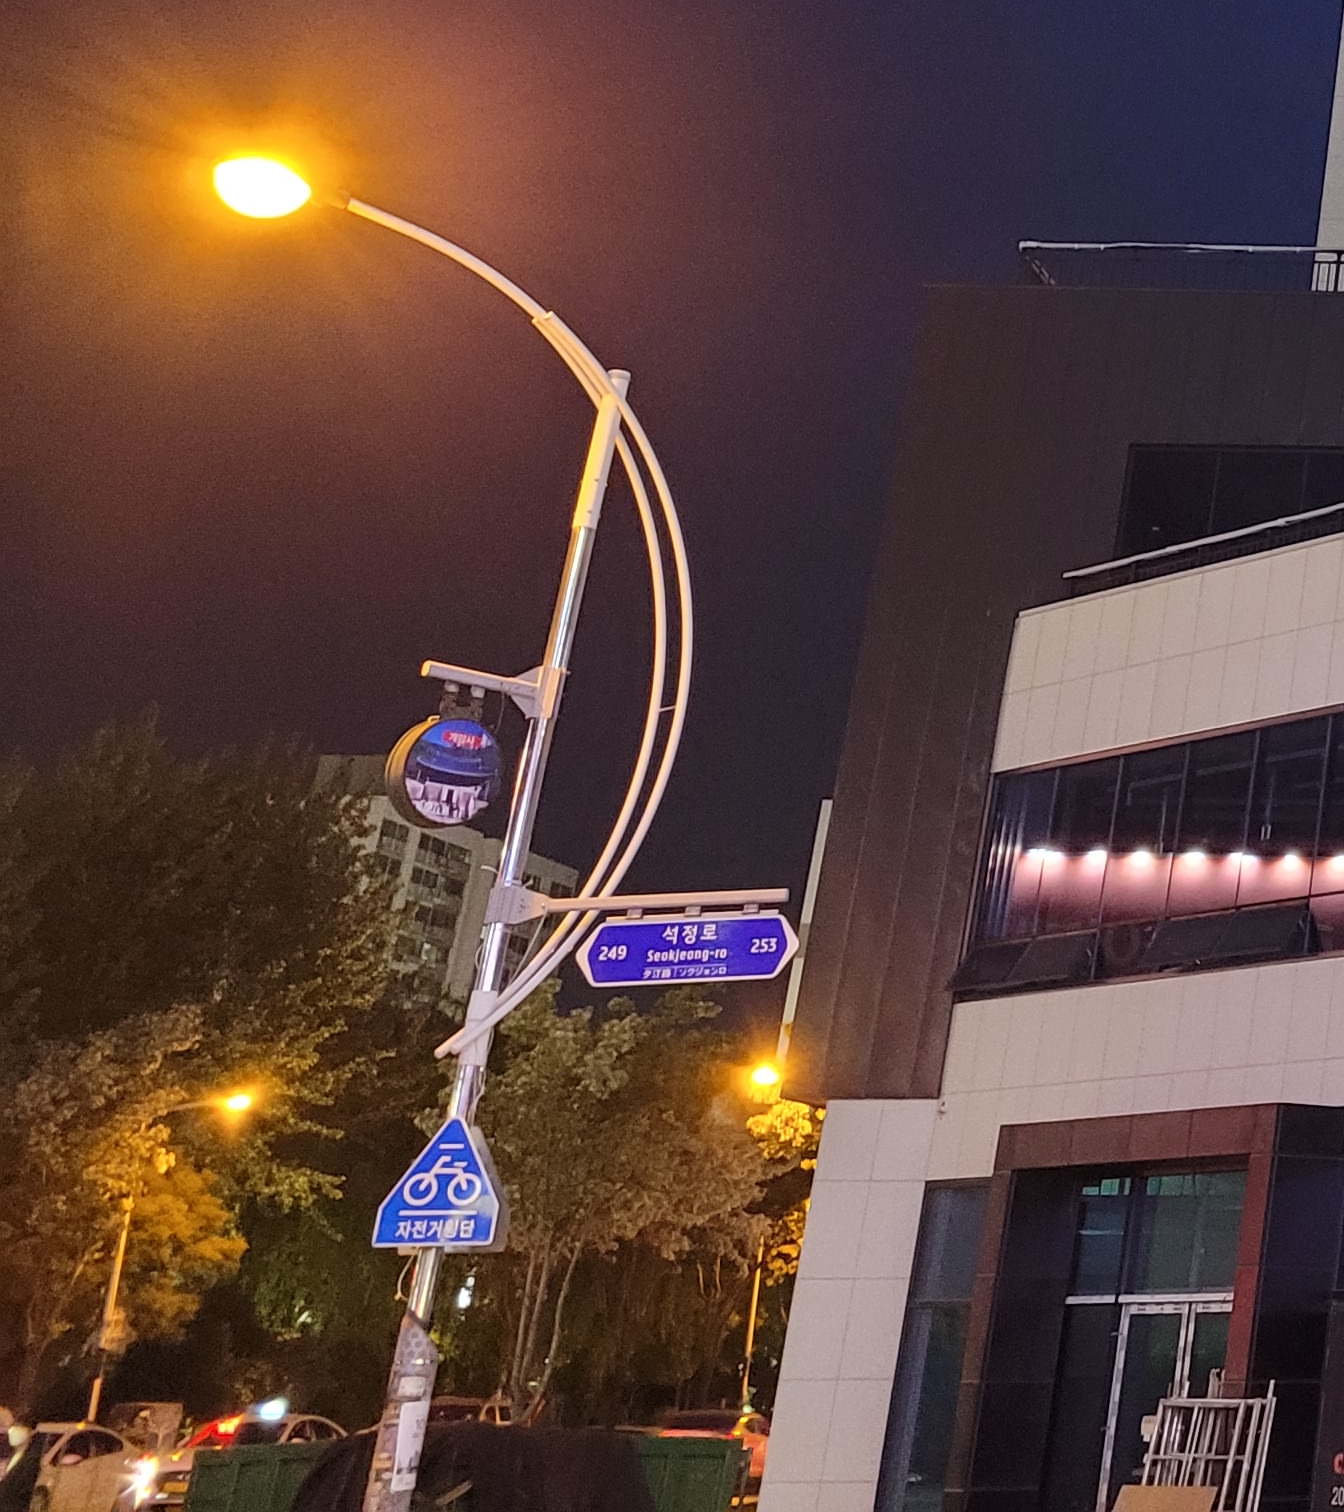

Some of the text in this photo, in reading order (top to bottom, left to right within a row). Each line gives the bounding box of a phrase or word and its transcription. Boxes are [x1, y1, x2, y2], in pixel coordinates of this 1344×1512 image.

[661, 923, 717, 944] 석정로
[599, 945, 627, 961] 249
[750, 937, 778, 953] 253
[646, 948, 727, 963] Seokjeong-ro
